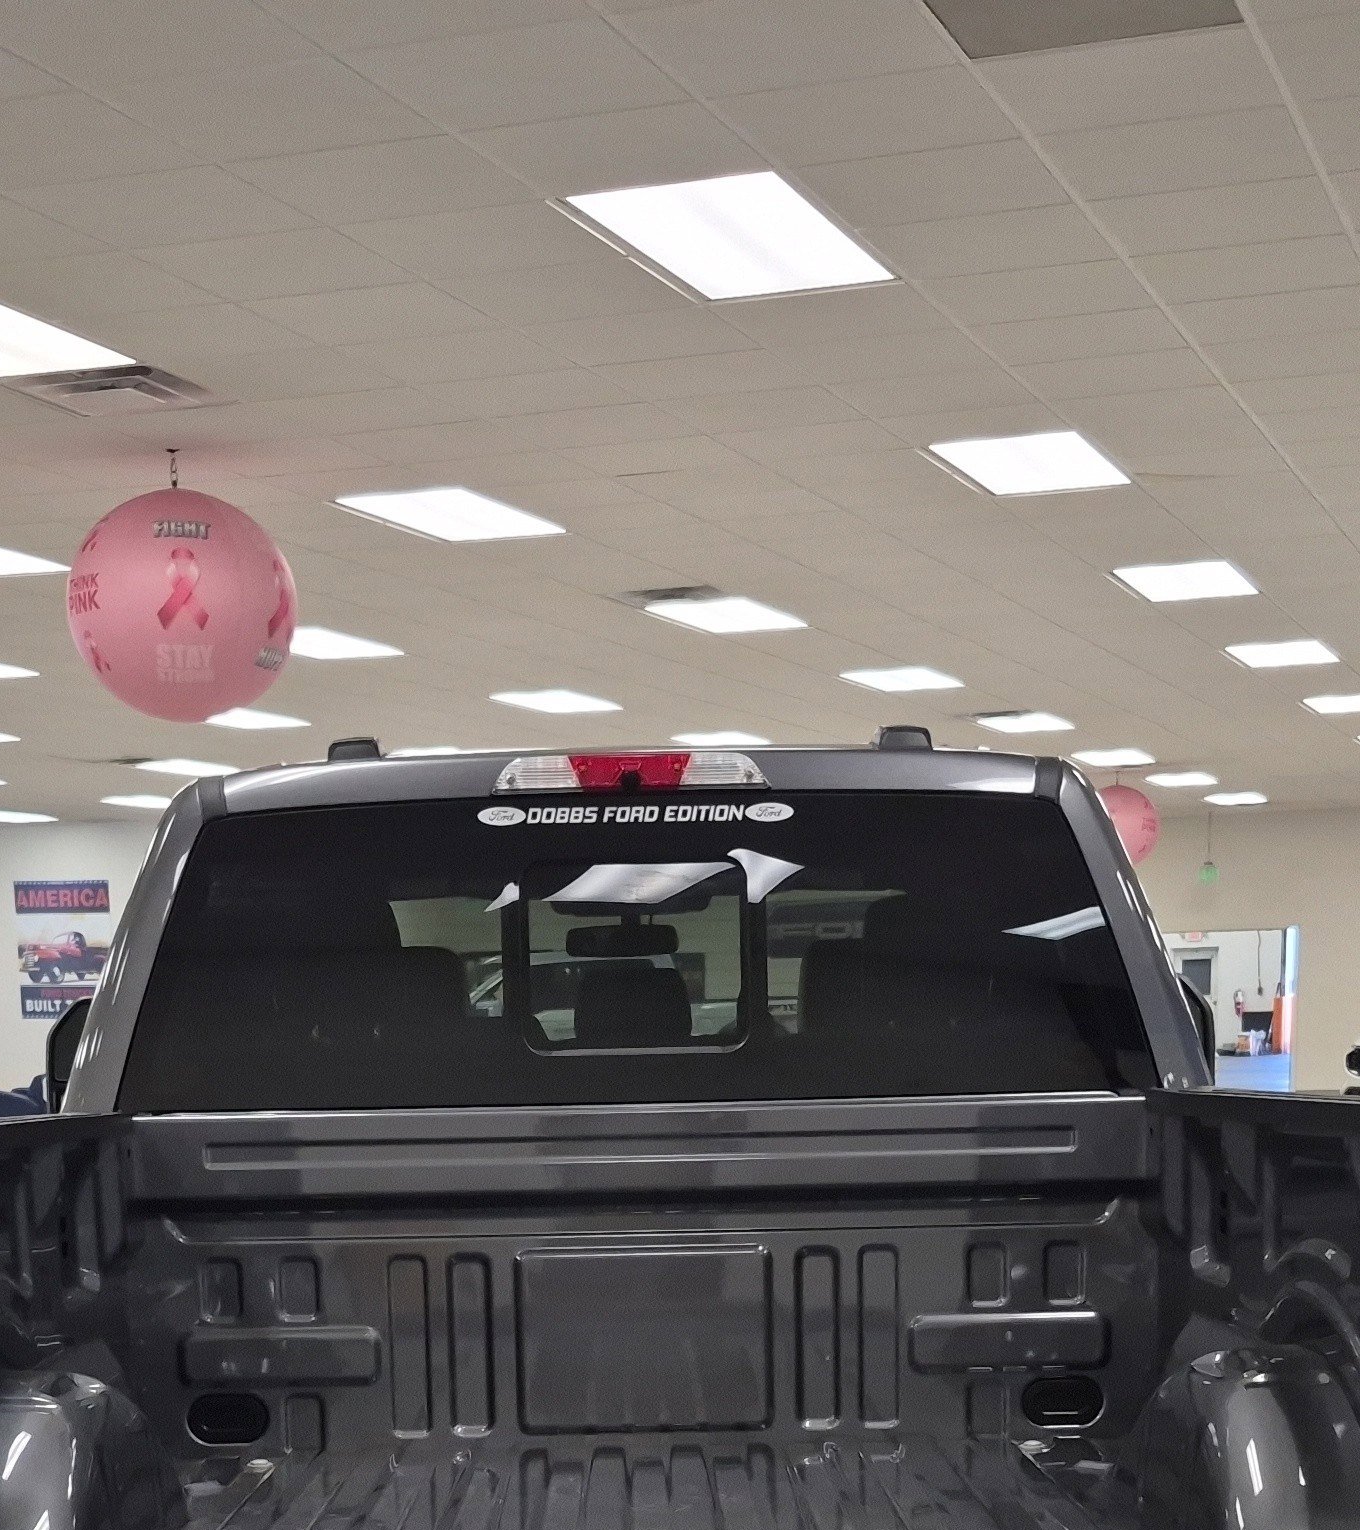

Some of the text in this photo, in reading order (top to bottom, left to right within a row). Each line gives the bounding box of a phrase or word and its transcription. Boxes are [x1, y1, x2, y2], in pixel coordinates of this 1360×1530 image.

[527, 806, 598, 824] DOBBS
[603, 805, 659, 823] FORD
[663, 804, 746, 822] EDITION
[17, 888, 108, 908] AMERICA
[25, 999, 62, 1013] BUILT
